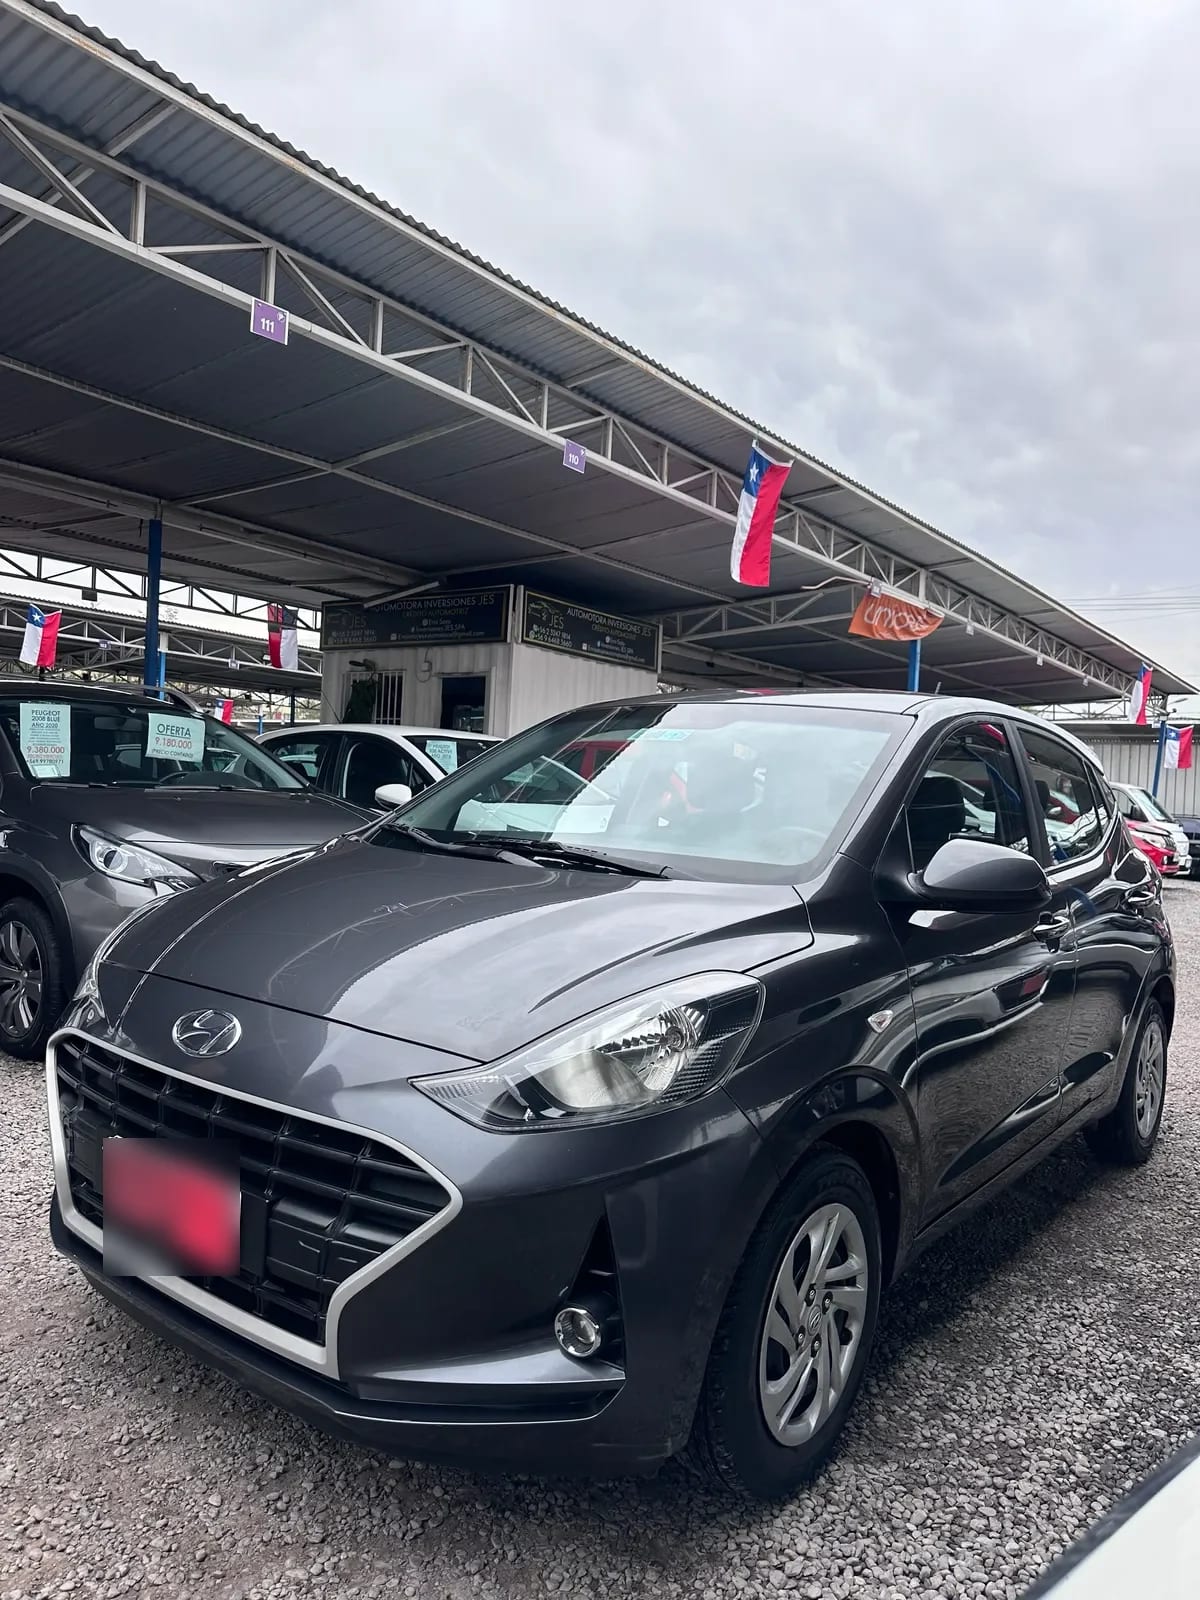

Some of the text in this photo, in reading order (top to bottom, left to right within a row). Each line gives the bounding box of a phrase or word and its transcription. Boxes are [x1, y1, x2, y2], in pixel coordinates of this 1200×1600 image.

[260, 317, 275, 334] 111
[568, 453, 579, 465] 110
[424, 598, 476, 609] INVERSIONES
[478, 594, 495, 606] JES
[549, 614, 564, 629] JES
[566, 608, 652, 637] AUTOMOTORA INVERSIONES JES
[157, 723, 192, 738] OFERTA
[26, 746, 65, 754] 9.380.000
[155, 736, 192, 750] 9.180.000
